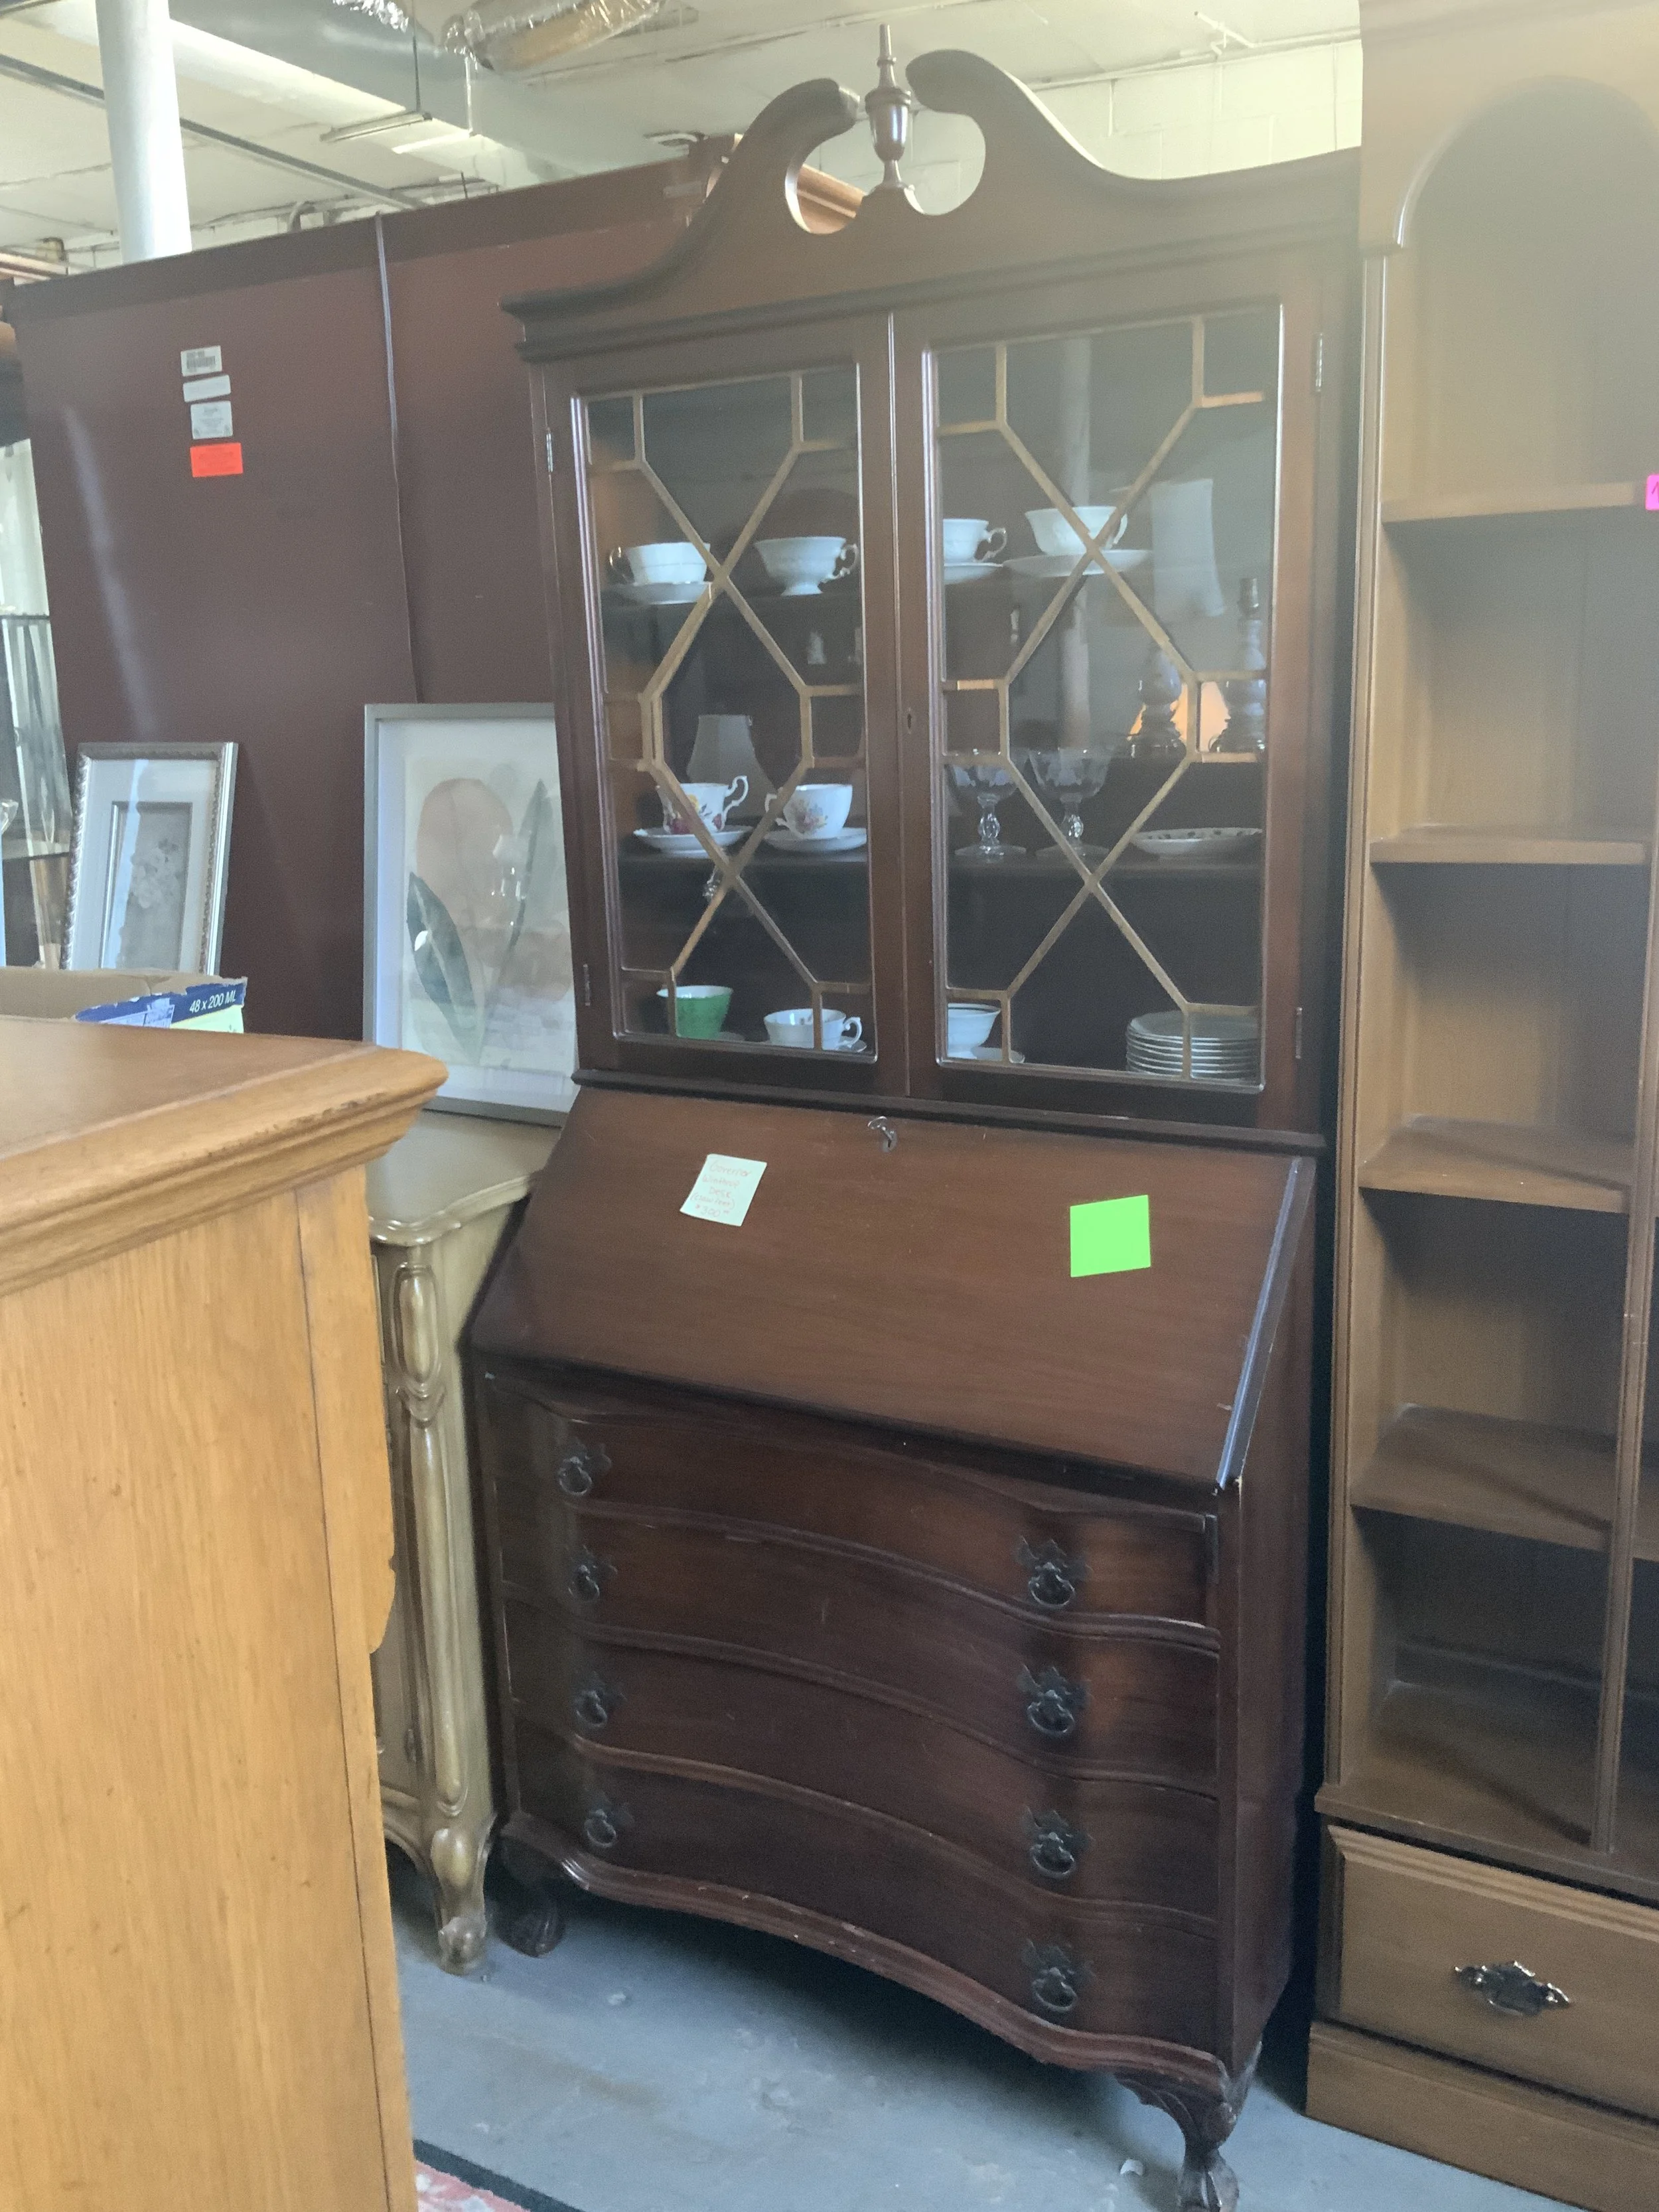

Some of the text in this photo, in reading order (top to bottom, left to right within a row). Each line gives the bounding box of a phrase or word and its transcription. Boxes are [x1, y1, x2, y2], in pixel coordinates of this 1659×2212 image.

[189, 990, 236, 1013] 48 x 200 ML
